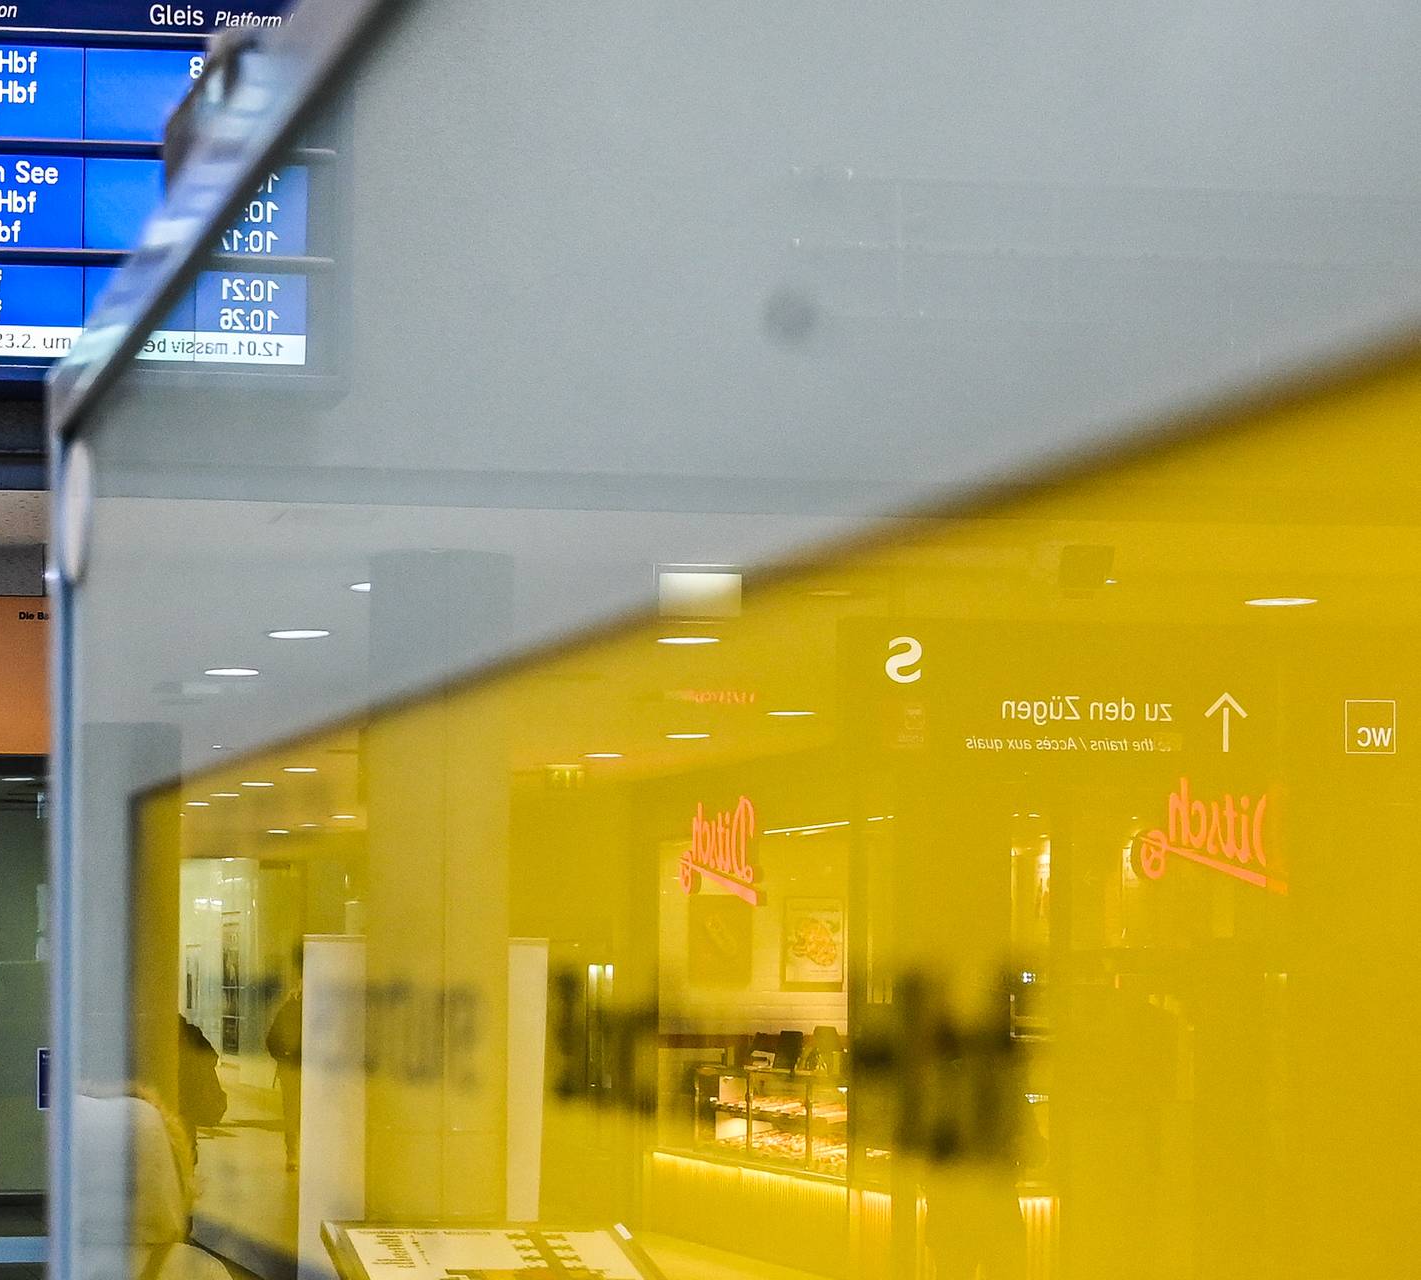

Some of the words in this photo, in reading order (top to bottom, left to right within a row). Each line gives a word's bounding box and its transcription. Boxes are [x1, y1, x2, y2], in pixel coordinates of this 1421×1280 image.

[149, 4, 204, 26] Gleis
[215, 11, 282, 28] Platform
[15, 160, 59, 185] See
